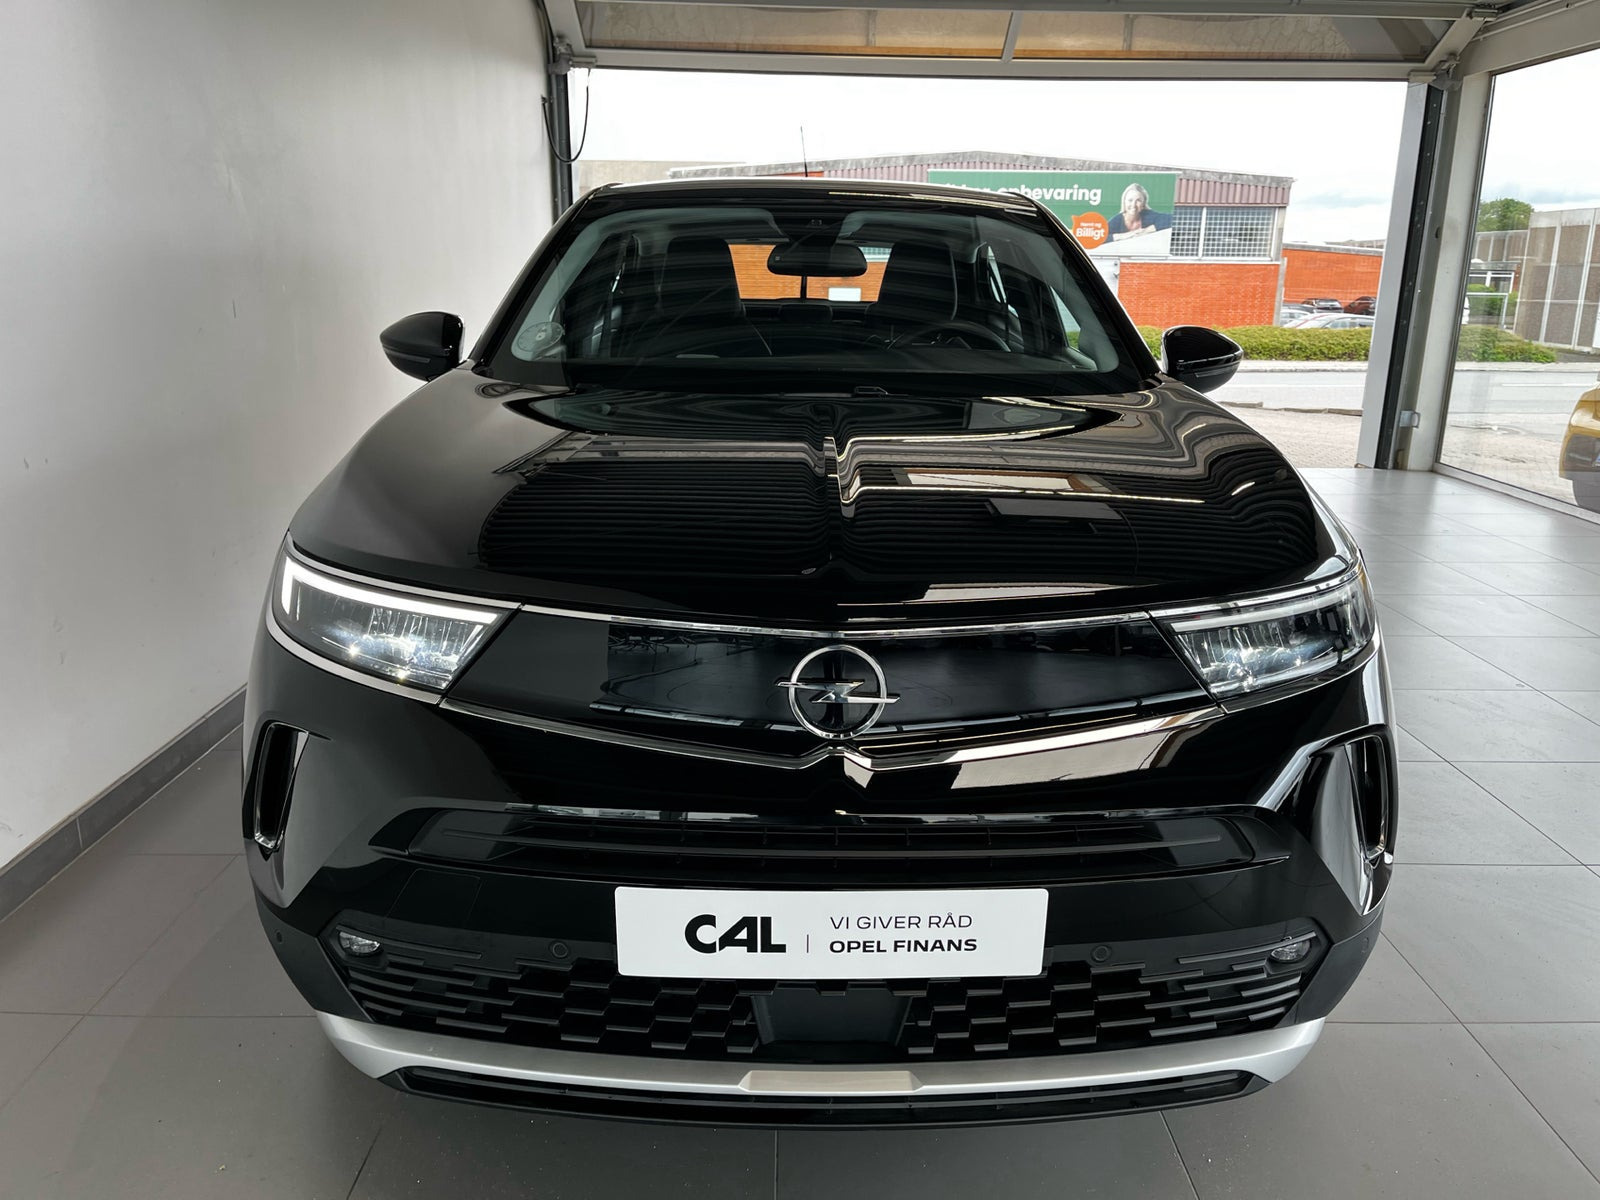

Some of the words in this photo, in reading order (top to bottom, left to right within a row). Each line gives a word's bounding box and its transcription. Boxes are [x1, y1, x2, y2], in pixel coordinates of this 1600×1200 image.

[1076, 227, 1105, 240] Billigt
[830, 916, 850, 930] VI
[856, 915, 922, 930] GIVER
[928, 912, 973, 929] RÅD
[684, 913, 787, 954] CAL
[829, 940, 887, 954] OPEL
[893, 938, 978, 953] FINANS
